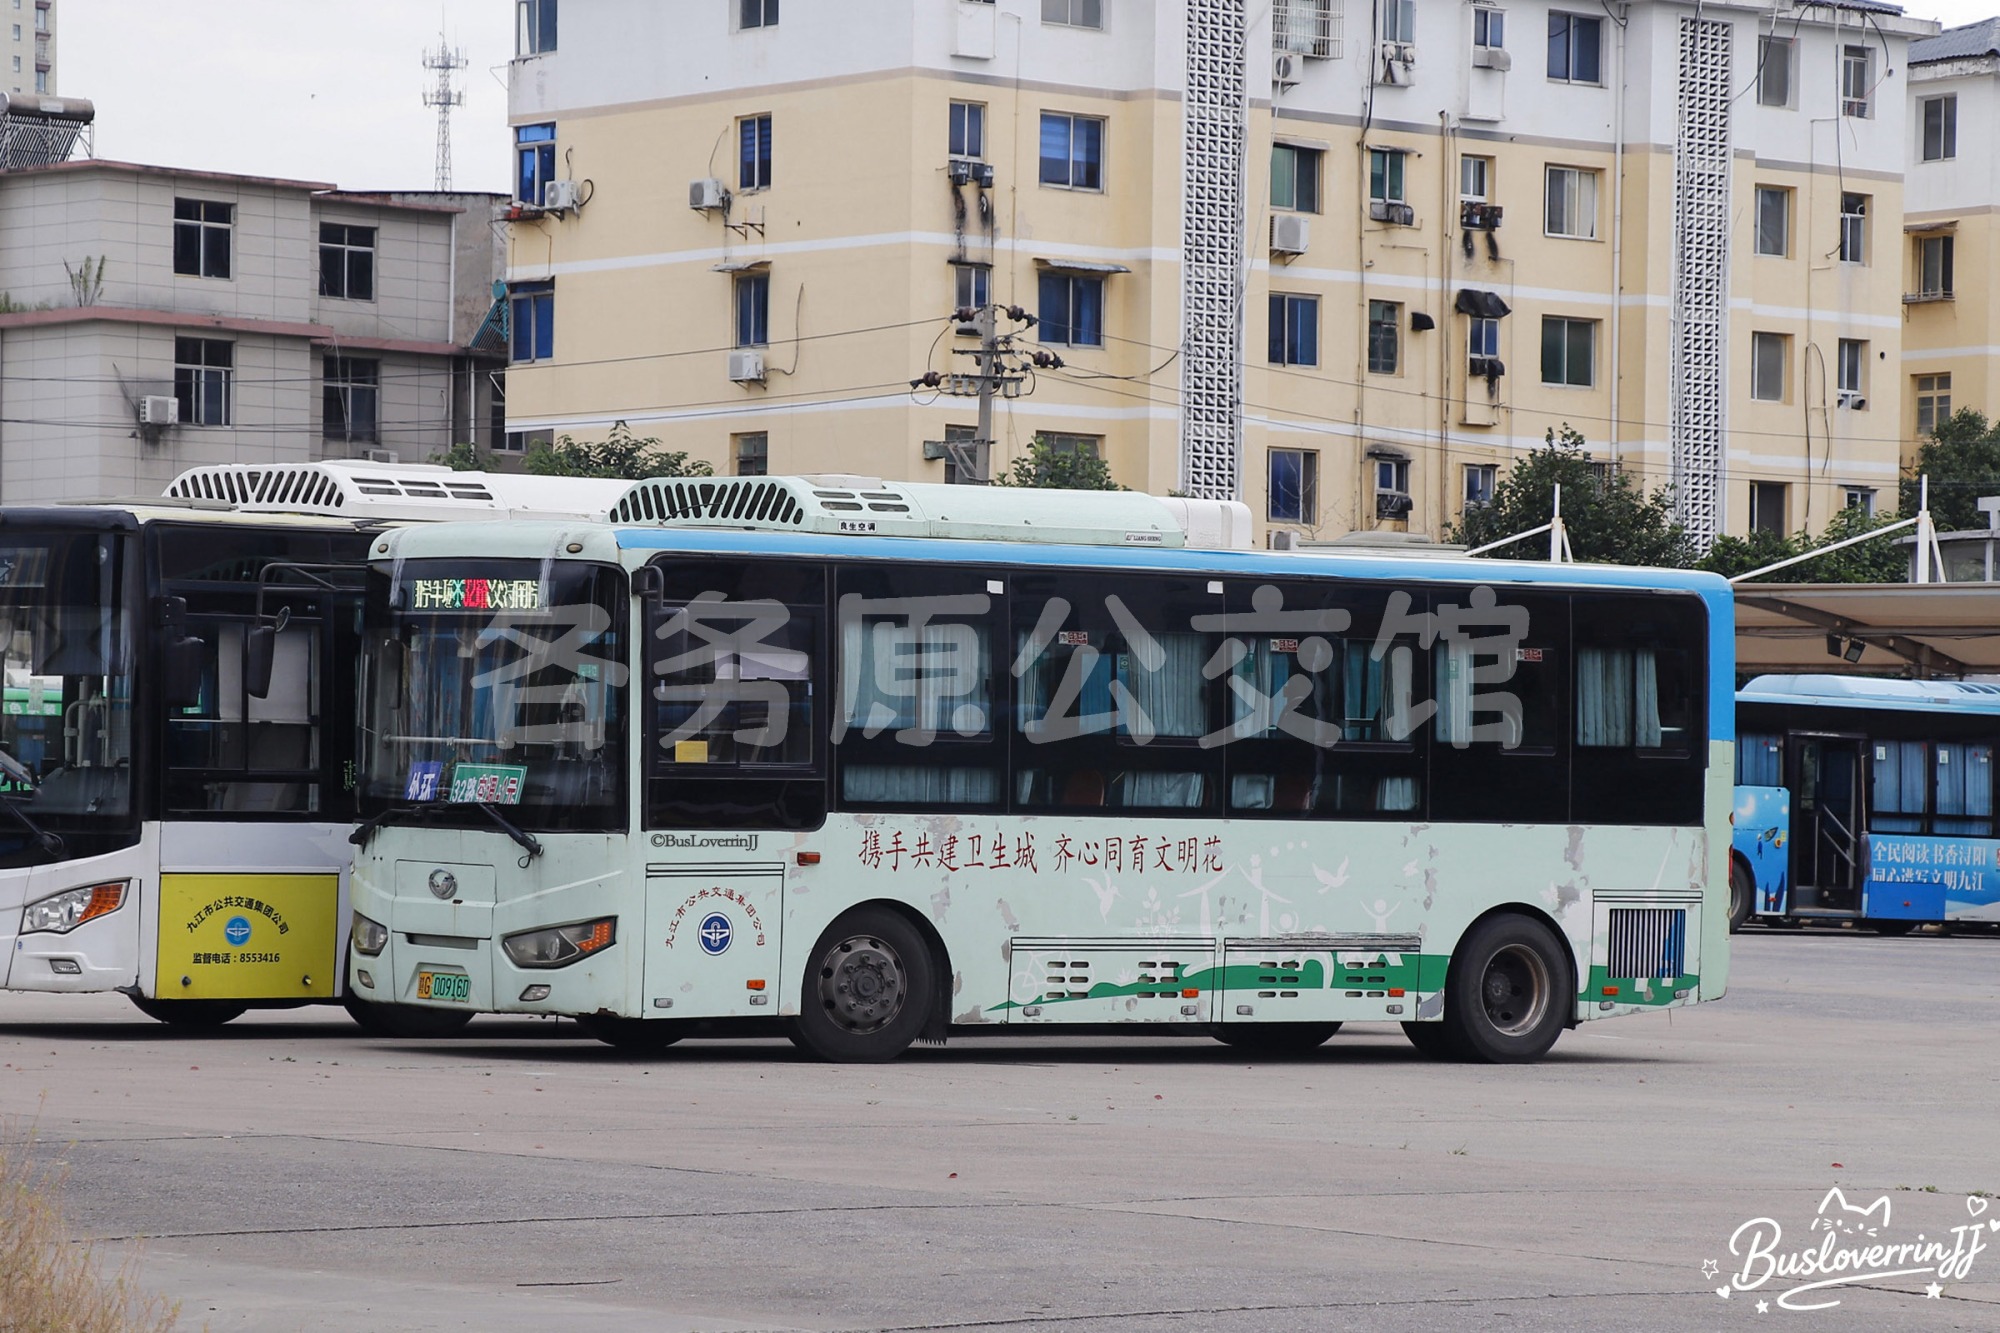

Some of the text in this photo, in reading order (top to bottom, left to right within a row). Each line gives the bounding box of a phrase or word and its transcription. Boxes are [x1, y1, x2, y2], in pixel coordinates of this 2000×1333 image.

[858, 829, 1224, 874] 携手共建卫生城 齐心同育文明花
[186, 895, 289, 935] 九江市公共交通集团公司
[665, 886, 765, 949] 九江市公共交通集团公司
